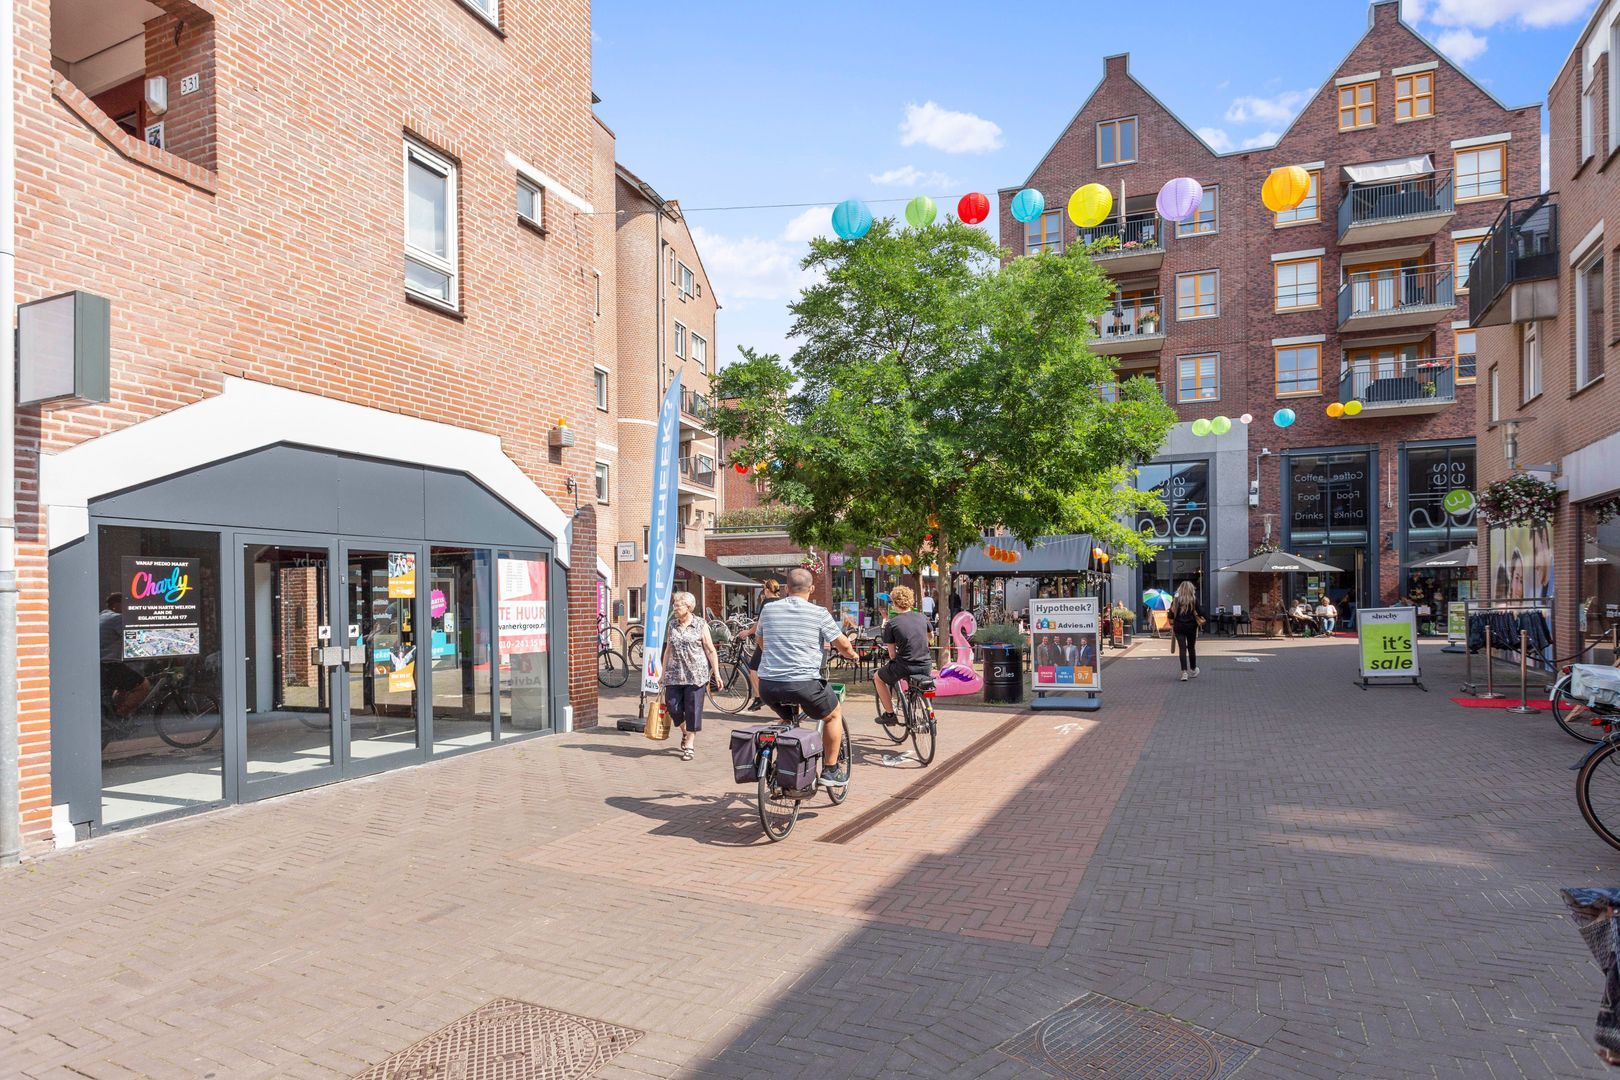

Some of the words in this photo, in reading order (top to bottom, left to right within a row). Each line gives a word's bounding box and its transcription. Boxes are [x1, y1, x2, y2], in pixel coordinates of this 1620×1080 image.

[182, 76, 197, 93] 331
[1295, 473, 1324, 482] Coffee
[1298, 493, 1320, 501] Food
[651, 399, 673, 638] HYPOTHEEK?
[1295, 512, 1324, 520] Drinks
[131, 566, 193, 603] Charly
[499, 607, 511, 620] TE
[516, 606, 546, 620] HUUR
[1036, 603, 1092, 613] Hypotheek?
[1383, 636, 1412, 650] it's
[1370, 655, 1413, 670] sale
